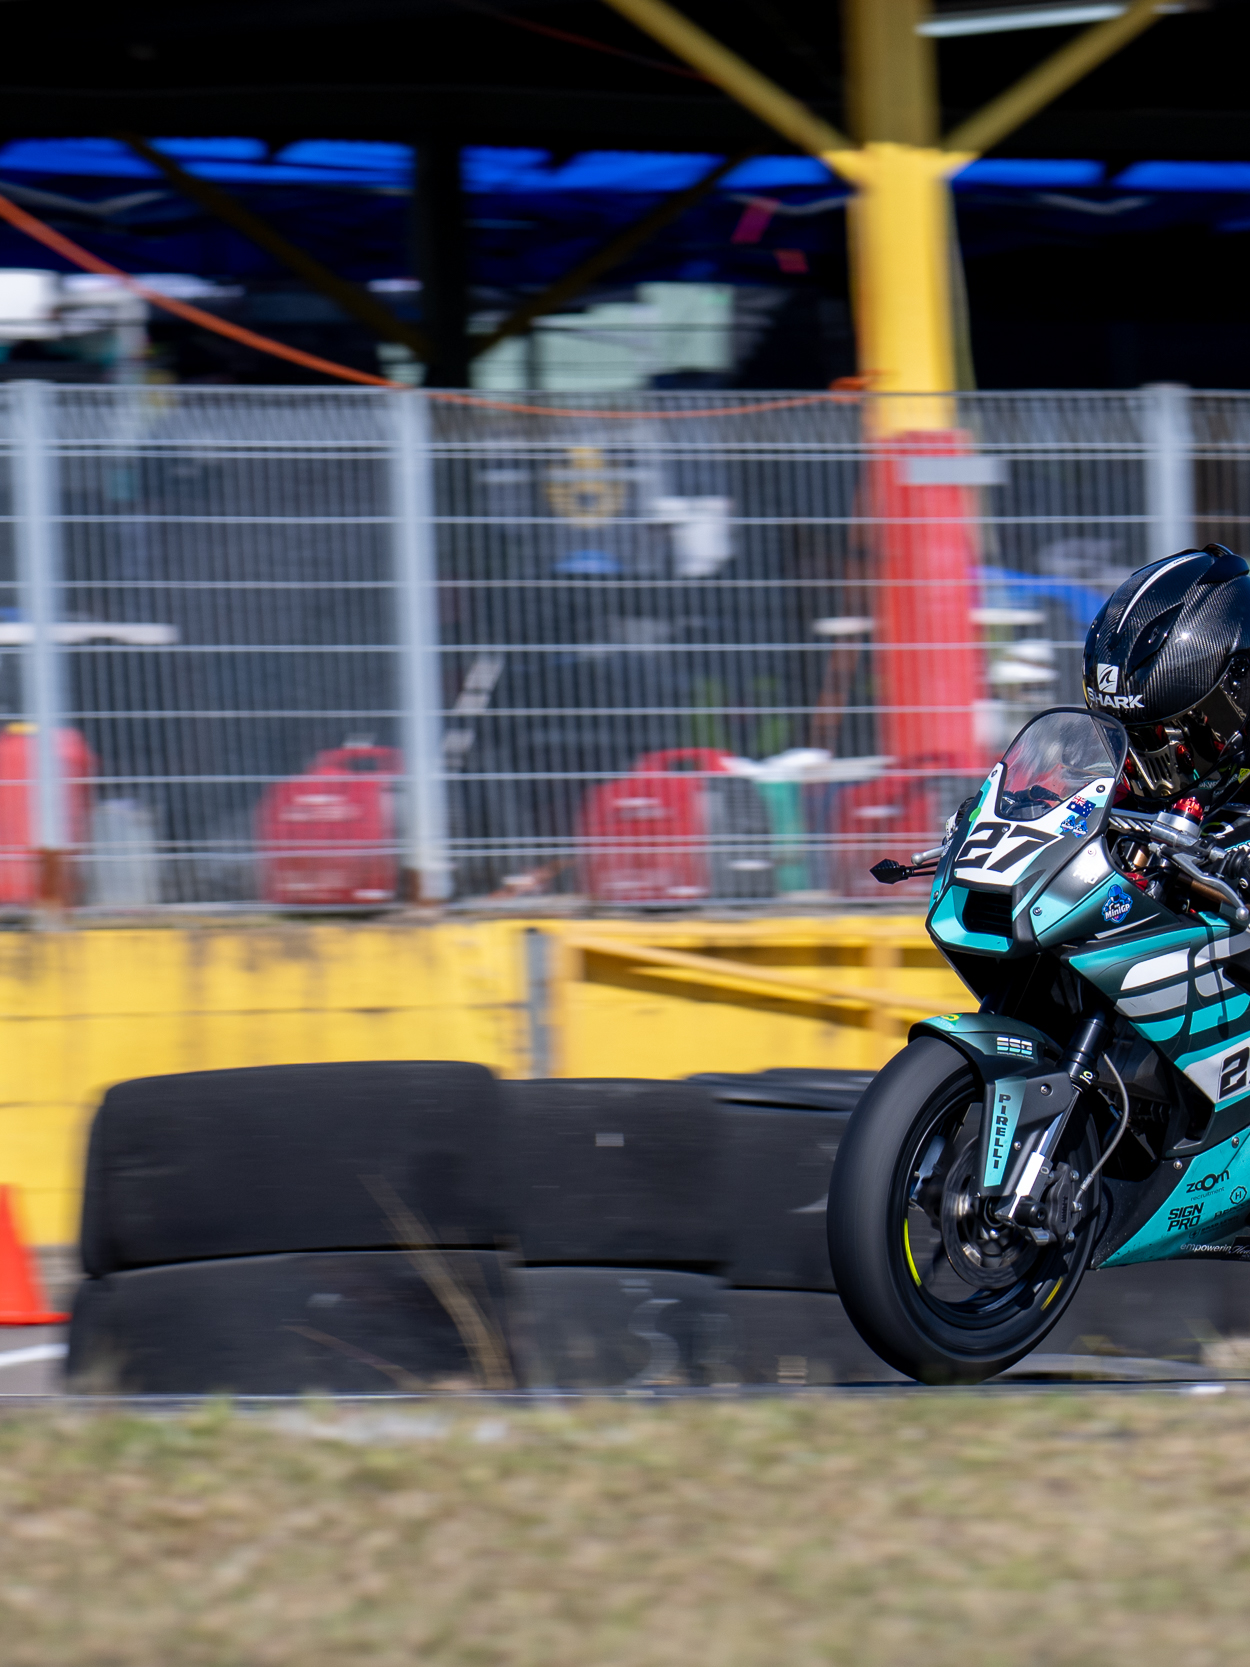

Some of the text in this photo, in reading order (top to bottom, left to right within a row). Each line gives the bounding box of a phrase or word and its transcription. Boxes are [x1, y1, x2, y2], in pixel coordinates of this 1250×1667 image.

[1086, 687, 1145, 709] SHARK
[955, 822, 1060, 874] 27
[993, 1094, 1011, 1169] PIRELLI
[1190, 1186, 1225, 1202] recruitment
[1167, 1202, 1205, 1220] SIGN
[1166, 1215, 1201, 1232] PRO
[1180, 1243, 1232, 1254] empowerin
